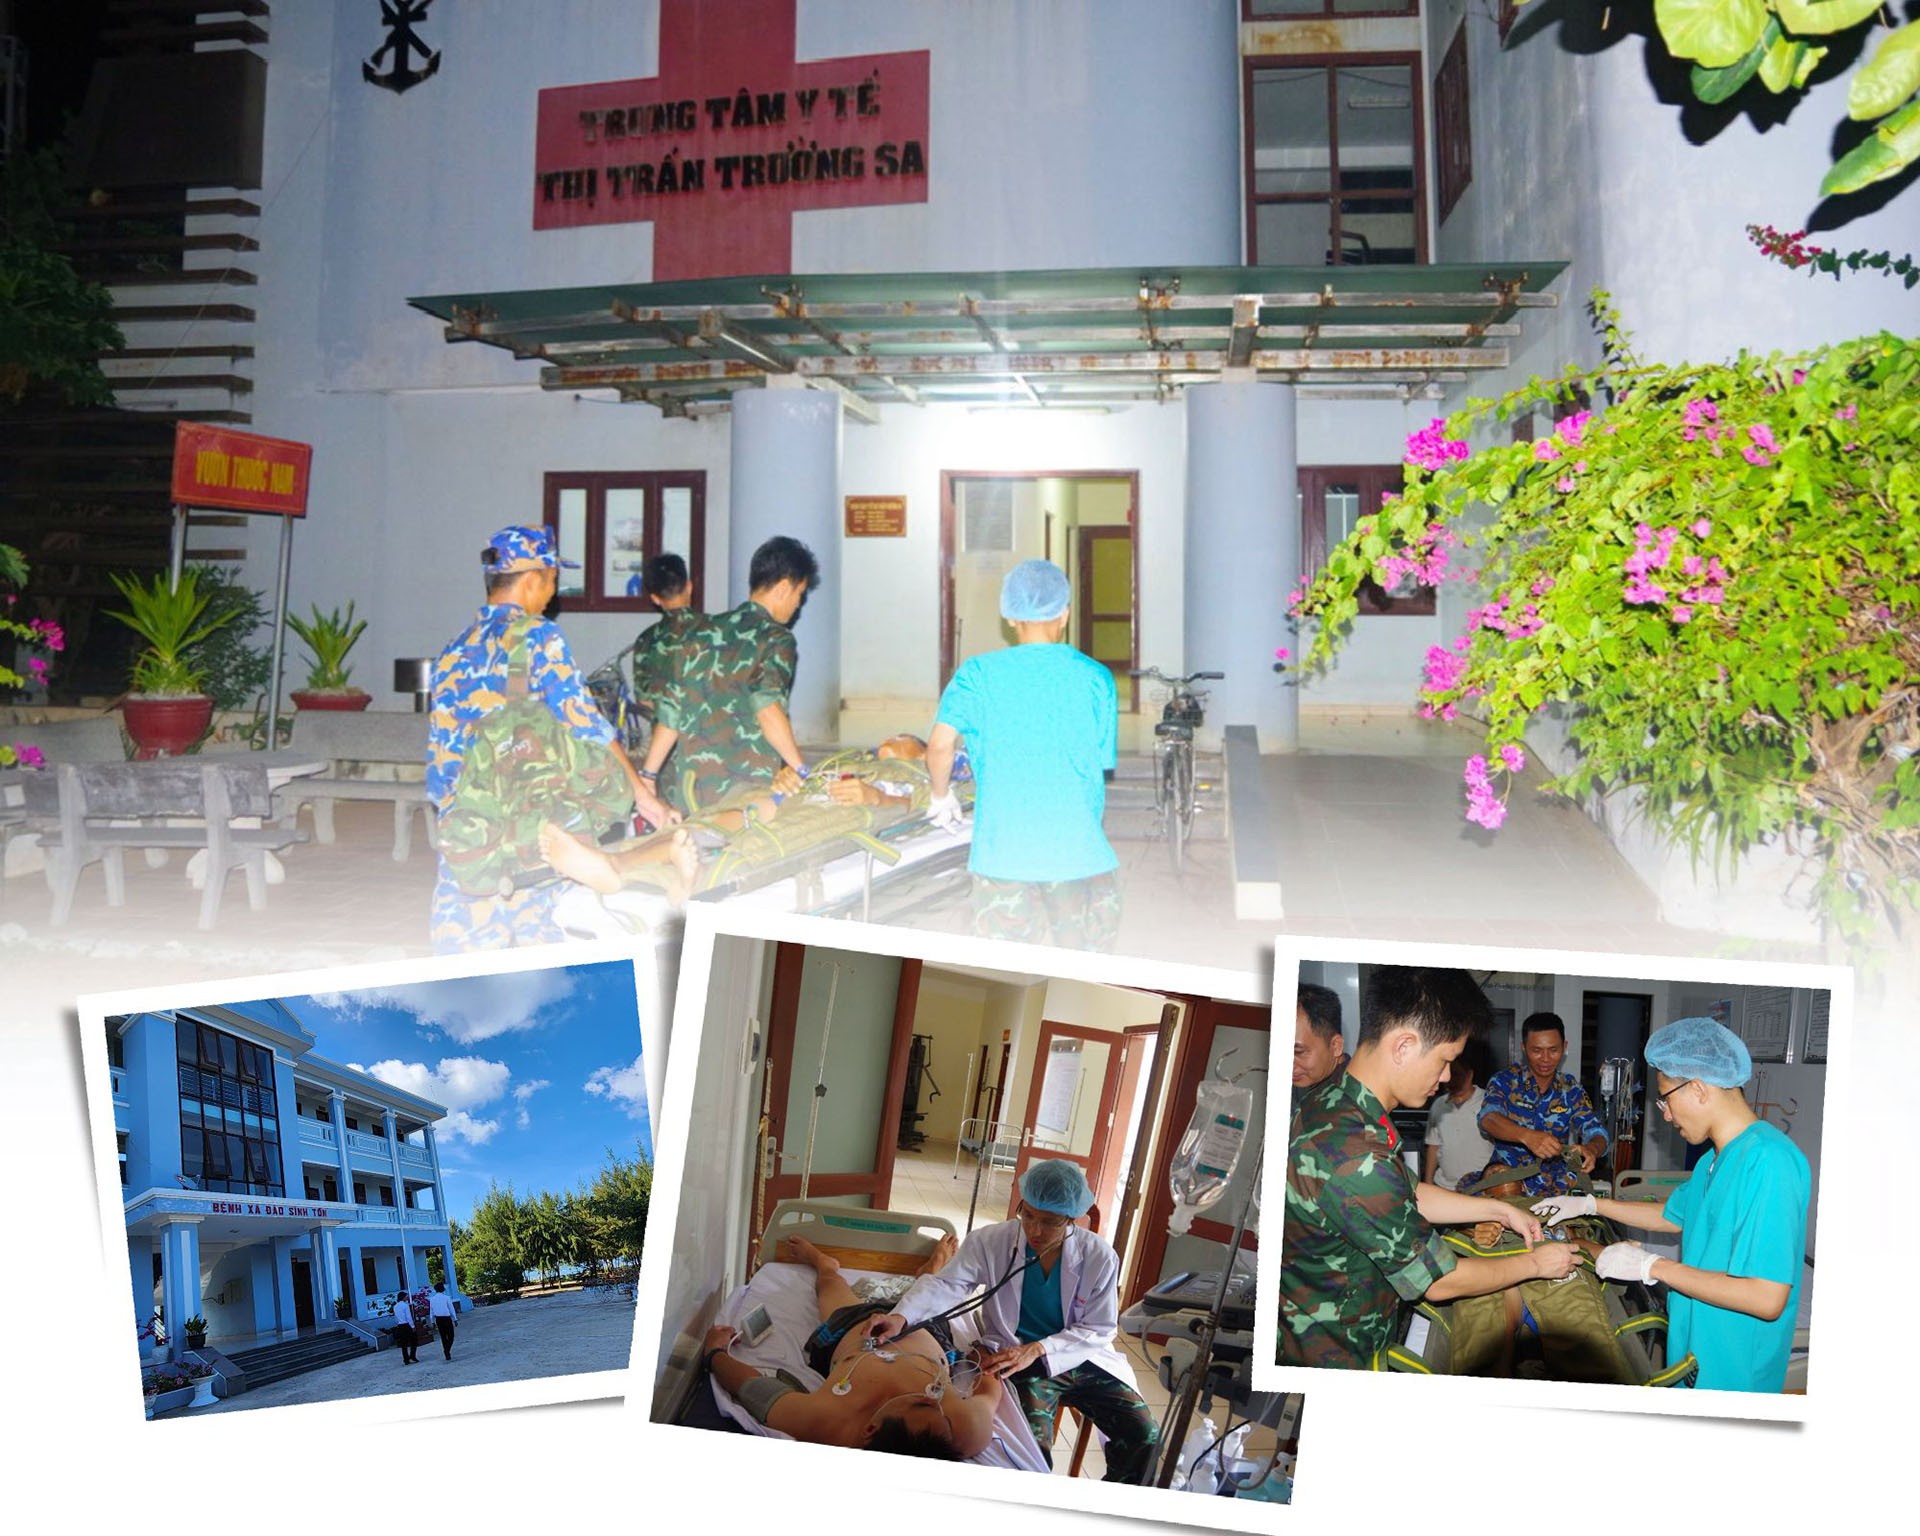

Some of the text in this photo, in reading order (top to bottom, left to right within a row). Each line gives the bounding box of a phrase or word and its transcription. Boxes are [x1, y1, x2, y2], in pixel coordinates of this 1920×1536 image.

[580, 99, 697, 142] TRUNG
[705, 87, 786, 129] TÂM
[796, 88, 819, 121] Y
[540, 136, 925, 208] THỊ TRẤN TRƯỜNG SA
